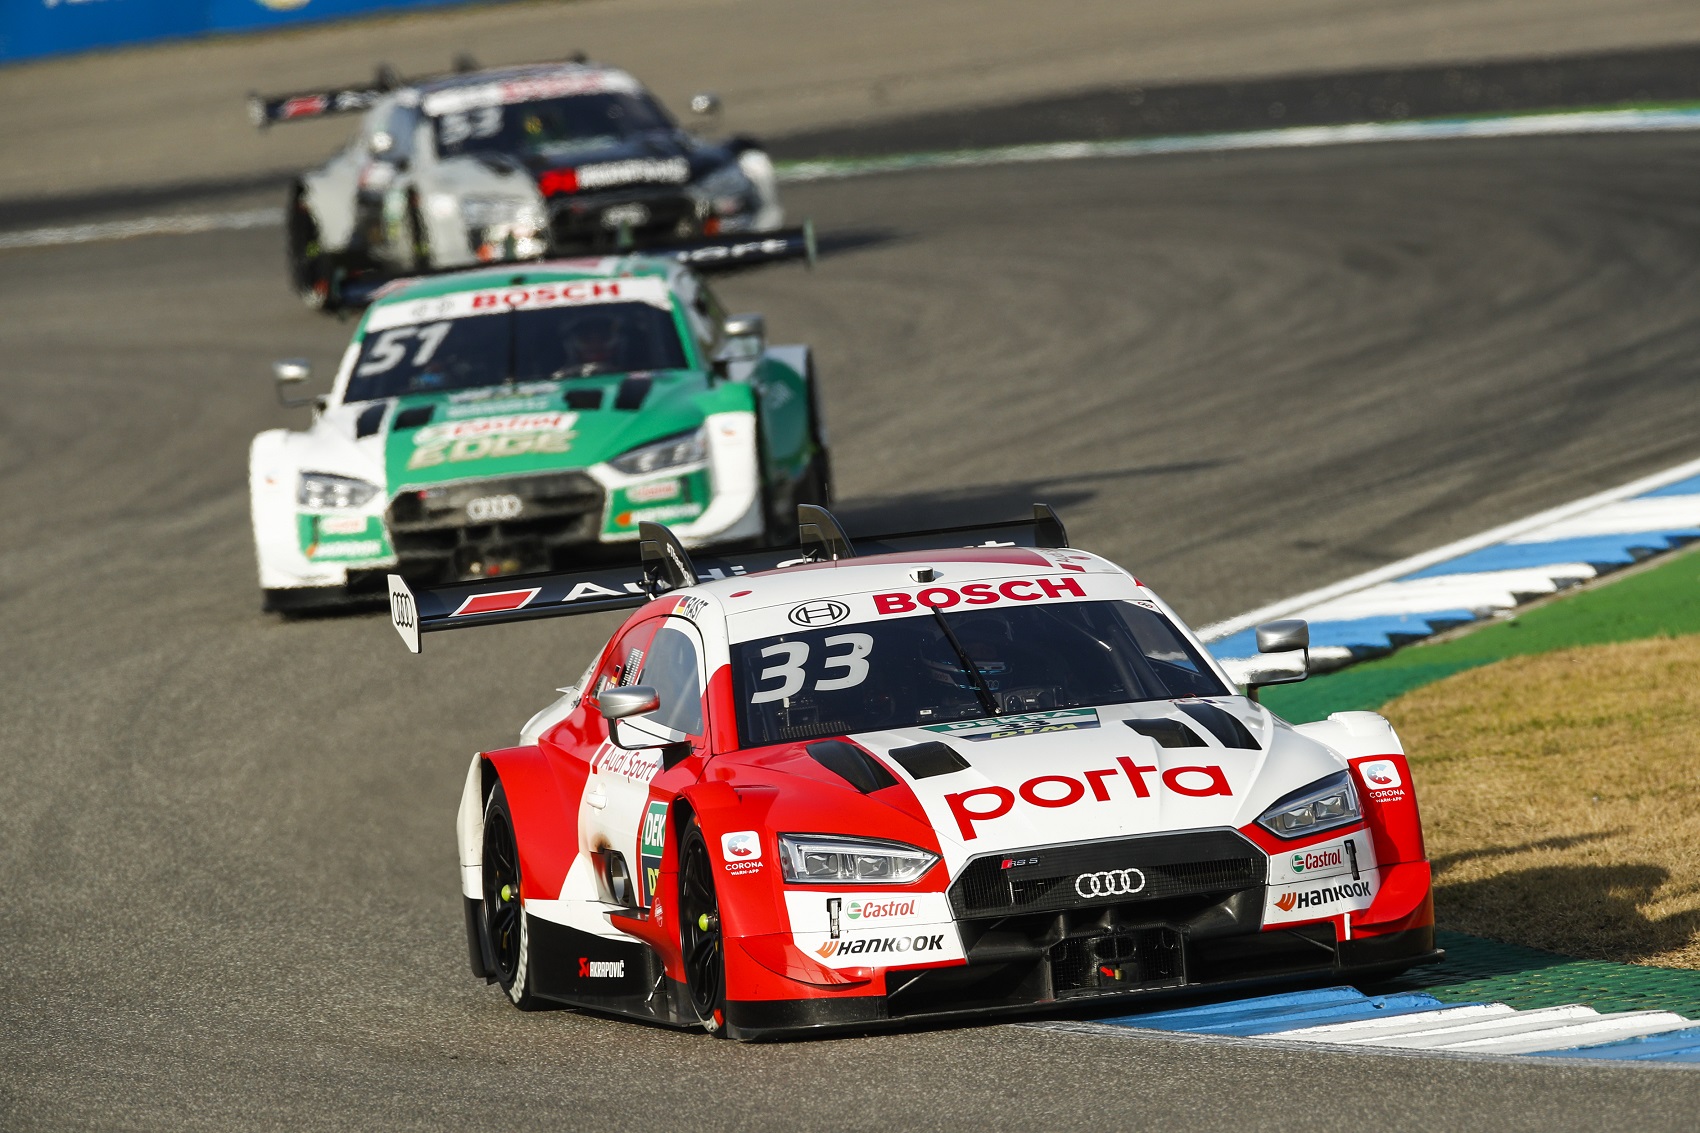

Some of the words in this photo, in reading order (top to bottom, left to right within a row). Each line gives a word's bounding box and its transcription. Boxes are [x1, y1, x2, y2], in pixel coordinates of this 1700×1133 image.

[472, 283, 620, 309] BOSCH
[356, 321, 452, 377] 51
[407, 430, 578, 470] EDGE
[872, 577, 1087, 615] BOSCH
[751, 632, 874, 704] 33
[947, 711, 1082, 730] DEKRA
[990, 723, 1078, 738] DTM
[601, 746, 631, 774] Audi
[623, 751, 658, 783] Sport
[944, 756, 1233, 841] porta
[1369, 790, 1405, 799] CORONA
[725, 861, 763, 871] CORONA
[1305, 848, 1341, 870] Castrol
[731, 868, 760, 876] WARN-APP
[863, 899, 915, 919] Castrol
